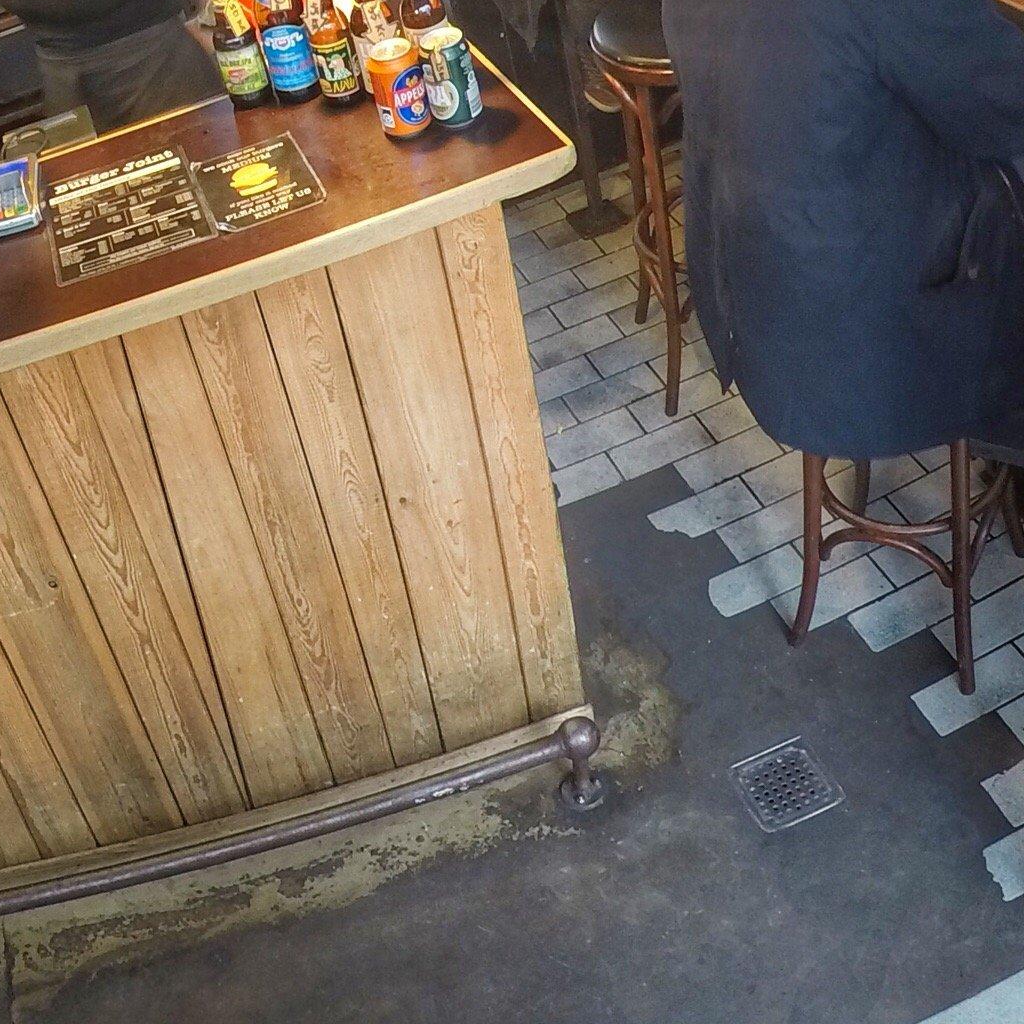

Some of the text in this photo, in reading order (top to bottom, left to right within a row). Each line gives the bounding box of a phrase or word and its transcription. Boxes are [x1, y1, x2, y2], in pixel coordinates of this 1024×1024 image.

[54, 149, 175, 195] Burger Joint
[220, 151, 272, 173] MEDIUM
[224, 201, 271, 222] PLEASE
[253, 202, 290, 220] KNOW
